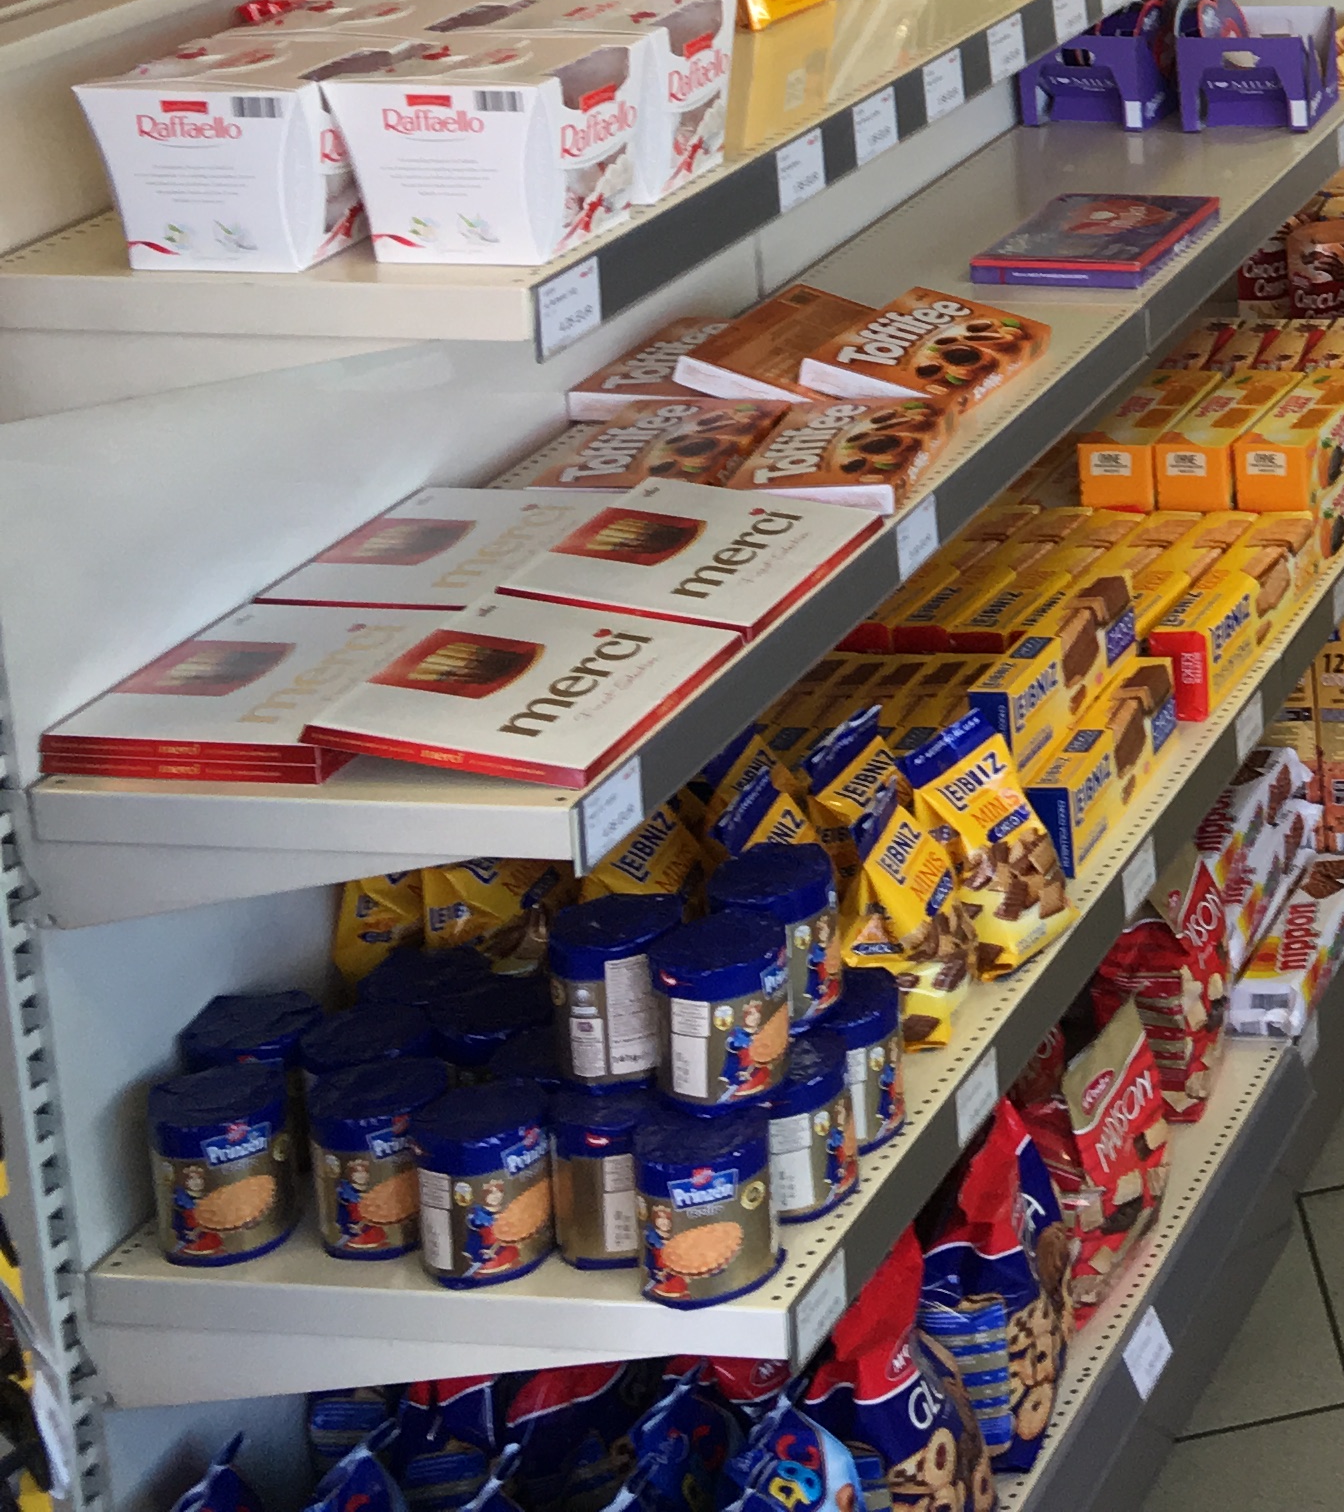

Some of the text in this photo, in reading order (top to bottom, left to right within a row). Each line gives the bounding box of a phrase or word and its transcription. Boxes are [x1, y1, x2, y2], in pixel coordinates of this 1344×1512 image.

[667, 49, 730, 105] Raffaello
[136, 113, 242, 141] Raffaello
[381, 107, 486, 136] Raffaello
[559, 100, 638, 159] Raffaello
[836, 297, 972, 367] Toffifee
[561, 401, 701, 483] Toffifee
[753, 401, 868, 484] Toffifee
[671, 506, 804, 600] merci
[239, 622, 406, 726] merci
[499, 627, 654, 738] merci
[1015, 660, 1059, 734] LEIBNIZ
[834, 749, 898, 810] LEIBNIZ
[941, 751, 1008, 813] LEIBNIZ
[975, 787, 1023, 831] MINIS
[610, 811, 678, 883] LEIBNIZ
[876, 821, 922, 885] LEIBNIZ
[1281, 902, 1320, 971] nippon
